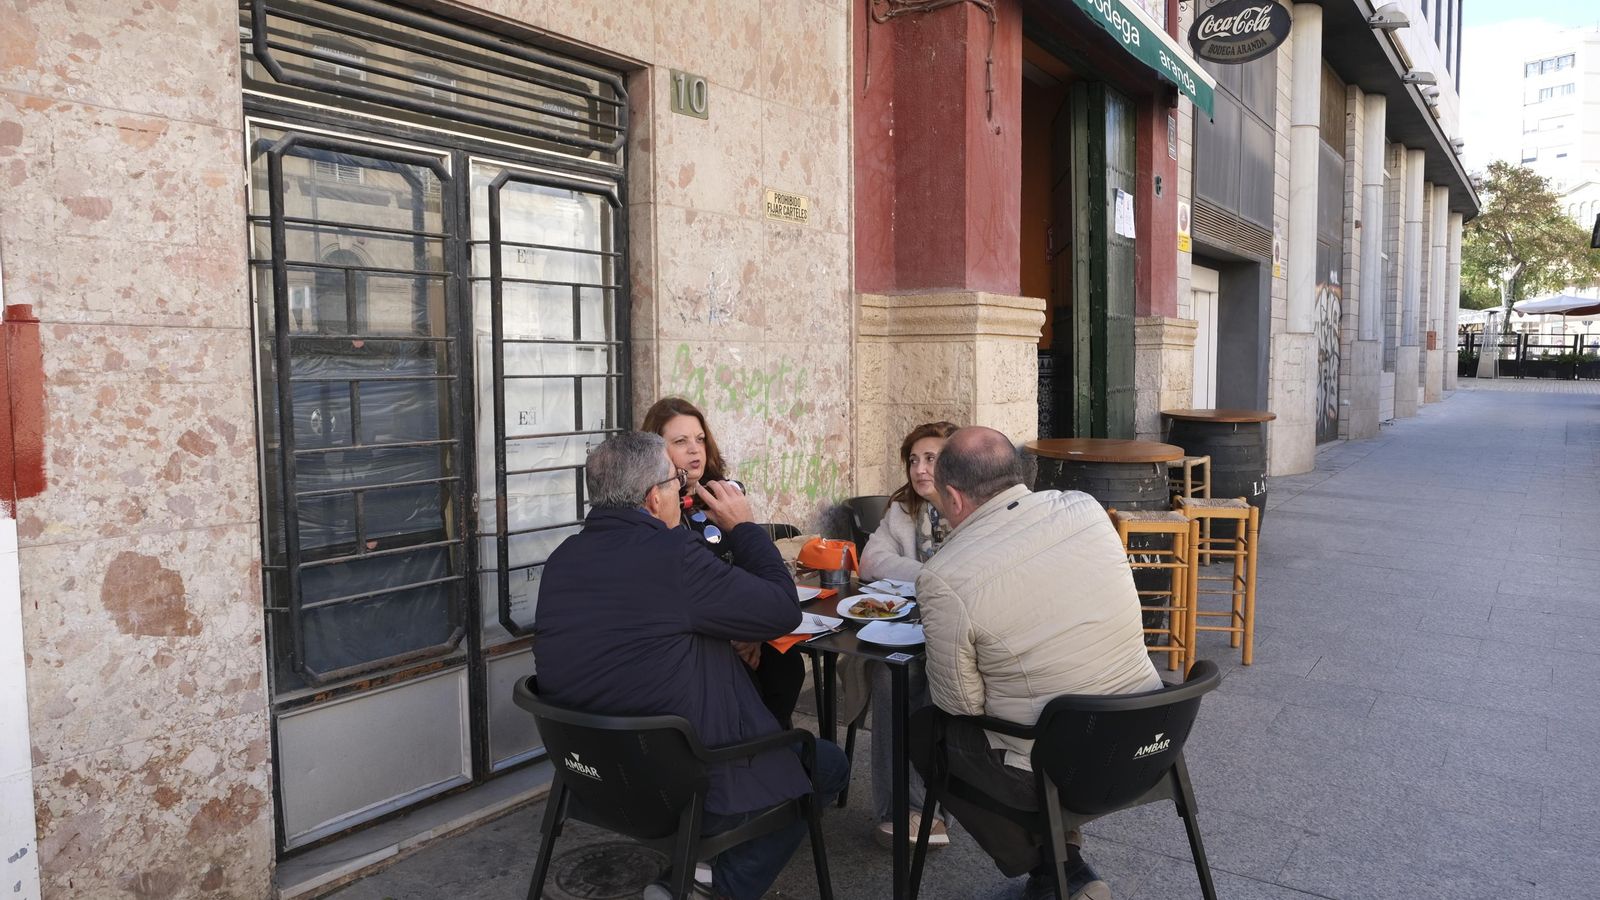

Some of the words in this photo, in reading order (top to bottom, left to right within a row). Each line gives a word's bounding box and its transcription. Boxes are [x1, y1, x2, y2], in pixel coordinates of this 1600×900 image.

[1087, 0, 1140, 47] odega
[1208, 43, 1235, 56] BODEGA
[1236, 38, 1267, 55] ARANDA
[1159, 50, 1196, 96] aranda
[674, 73, 707, 113] 10
[774, 192, 801, 207] PROHIBIDO
[767, 202, 782, 216] FIJAR
[783, 205, 808, 220] CARTELES
[1134, 739, 1171, 757] AMBAR
[564, 757, 601, 779] AMBAR
